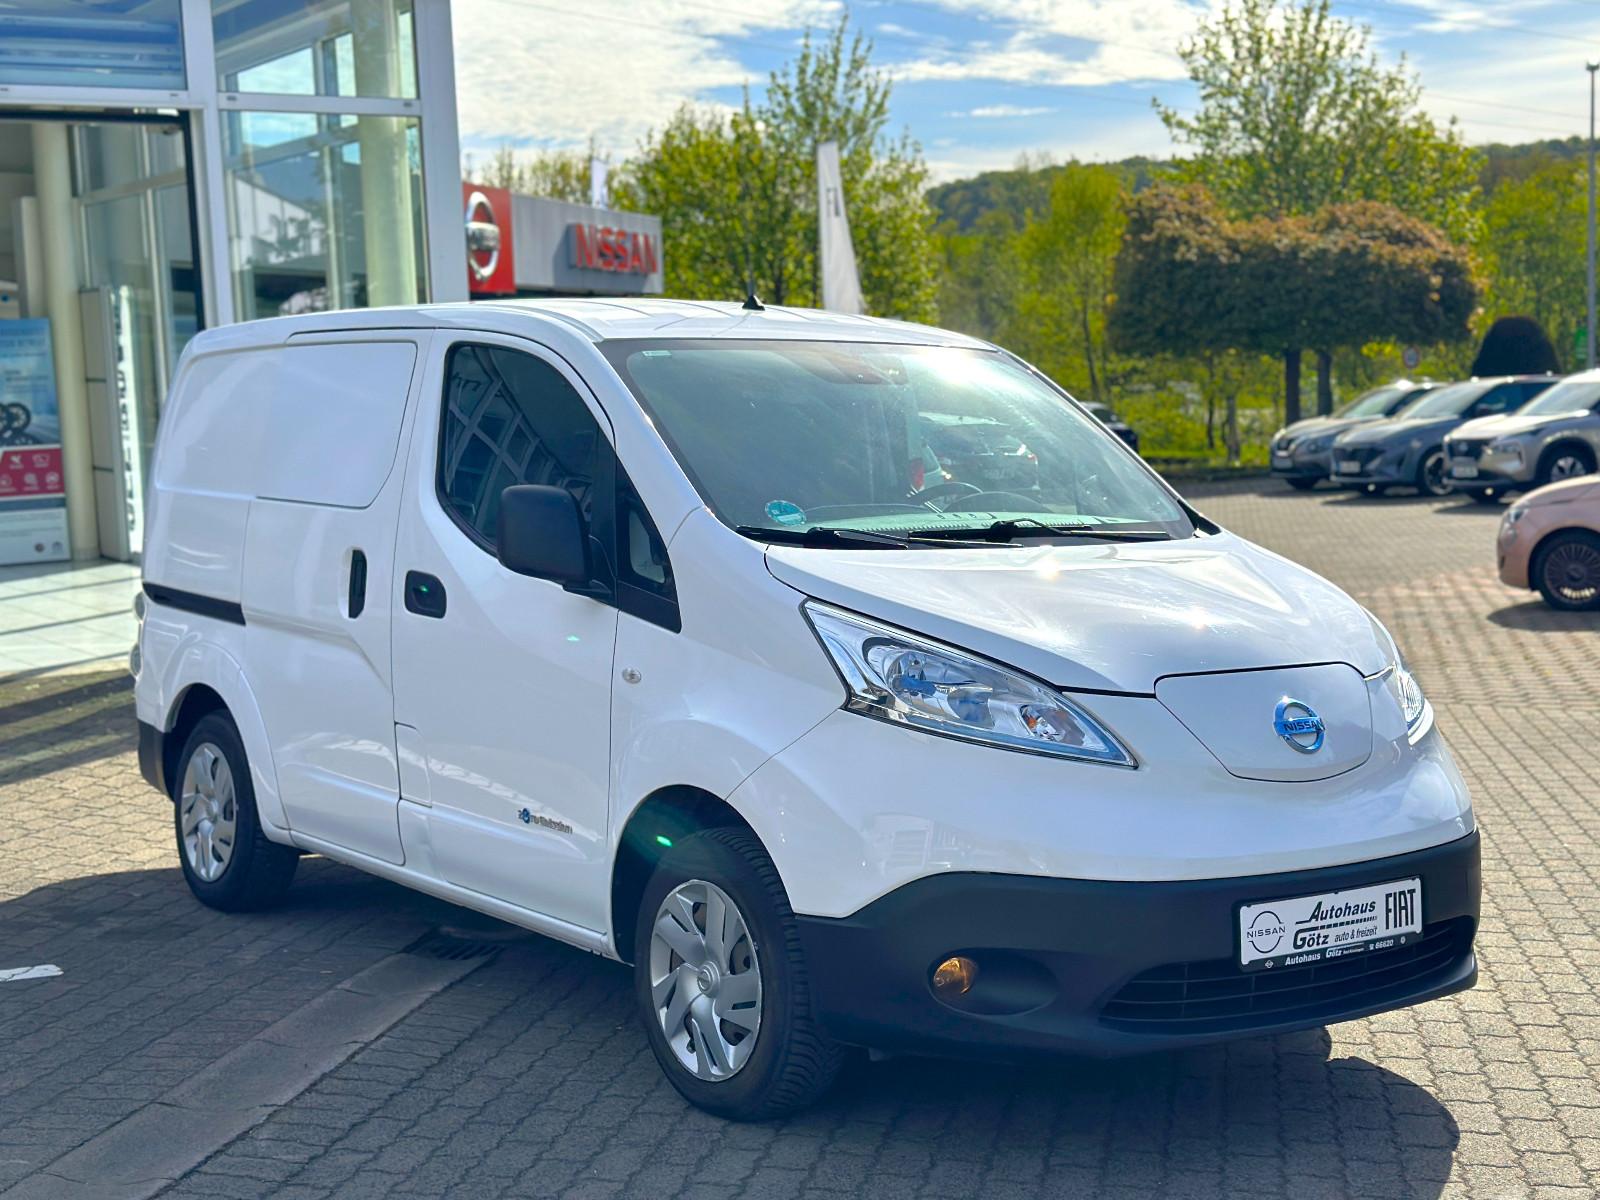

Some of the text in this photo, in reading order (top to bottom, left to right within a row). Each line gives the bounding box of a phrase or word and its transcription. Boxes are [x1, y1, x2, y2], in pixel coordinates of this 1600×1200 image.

[574, 222, 658, 274] NISSAN
[1283, 718, 1325, 732] NISSAN
[1297, 899, 1376, 925] Autohaus
[1385, 888, 1416, 930] FIAT
[1246, 925, 1286, 939] NISSAN
[1292, 926, 1378, 950] Götz auto & freizeit
[1285, 951, 1321, 966] Autohaus
[1326, 947, 1343, 959] Götz
